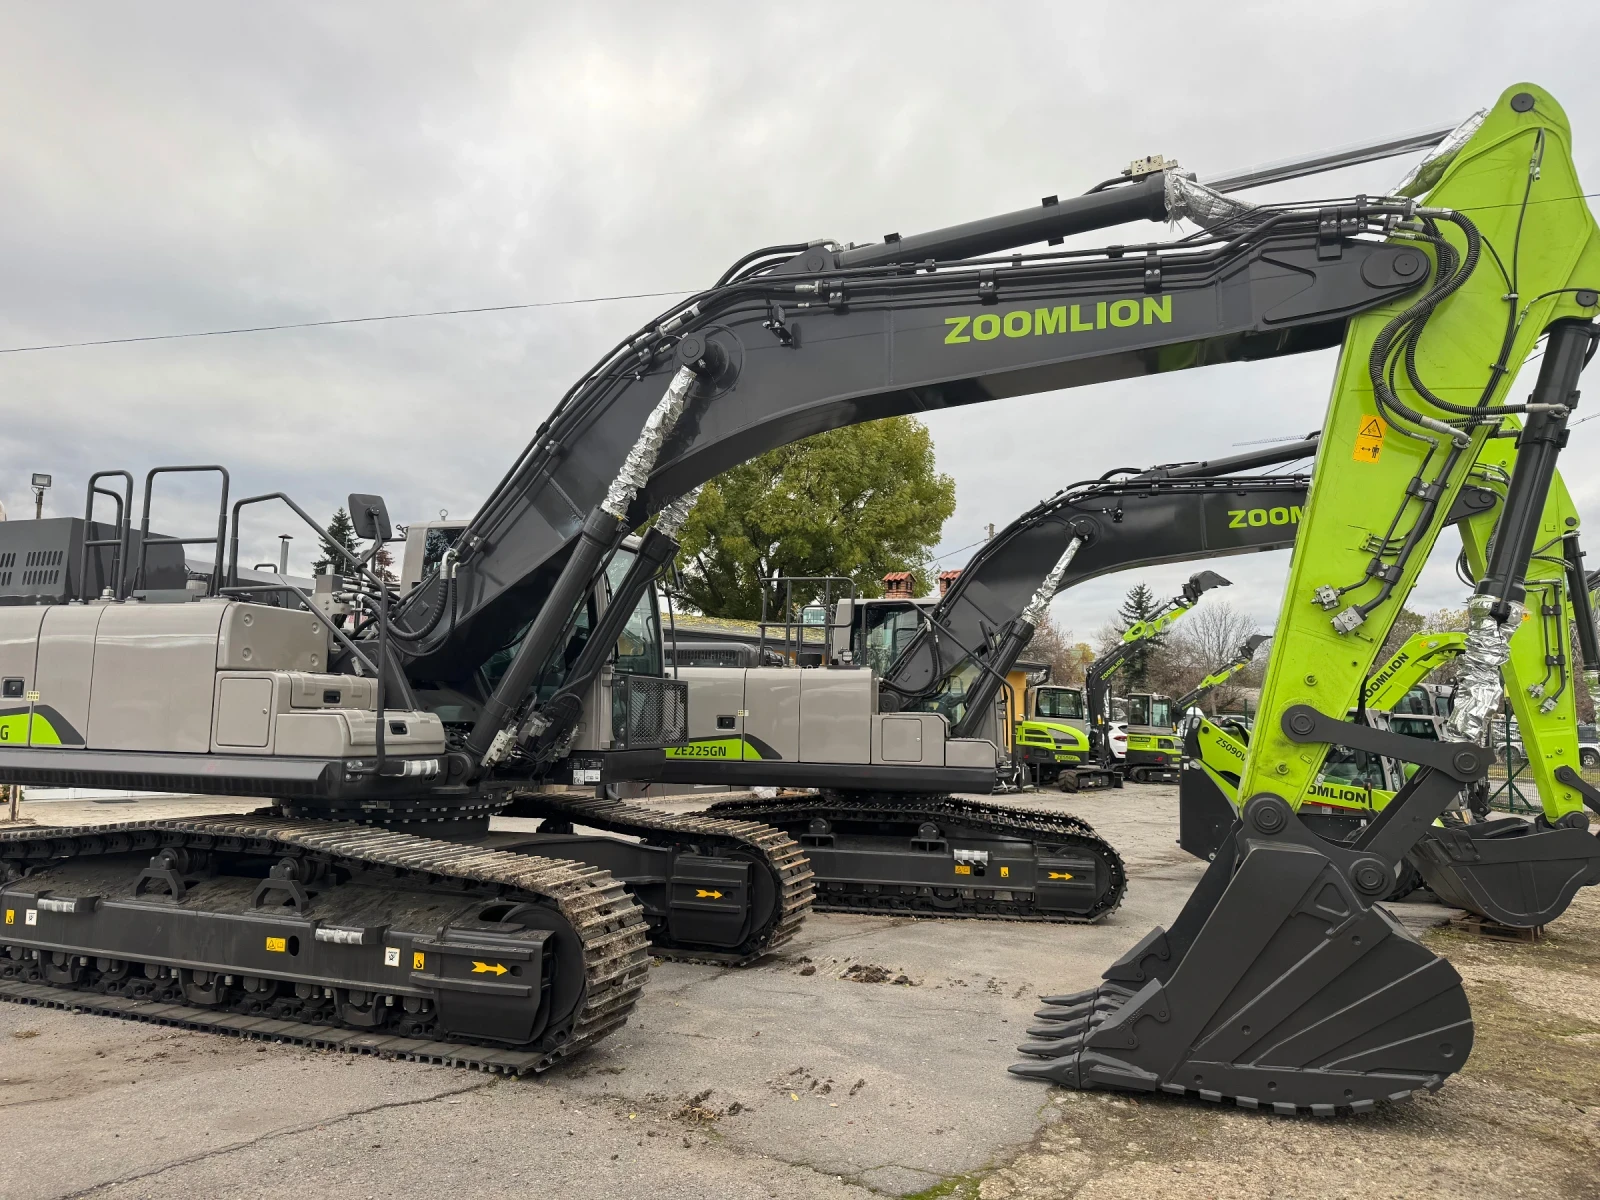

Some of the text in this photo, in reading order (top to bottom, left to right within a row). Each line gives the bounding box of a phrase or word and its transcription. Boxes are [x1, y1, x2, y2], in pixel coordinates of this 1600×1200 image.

[944, 294, 1172, 344] ZOOMLION
[0, 724, 9, 740] G
[674, 746, 726, 756] ZE225GN
